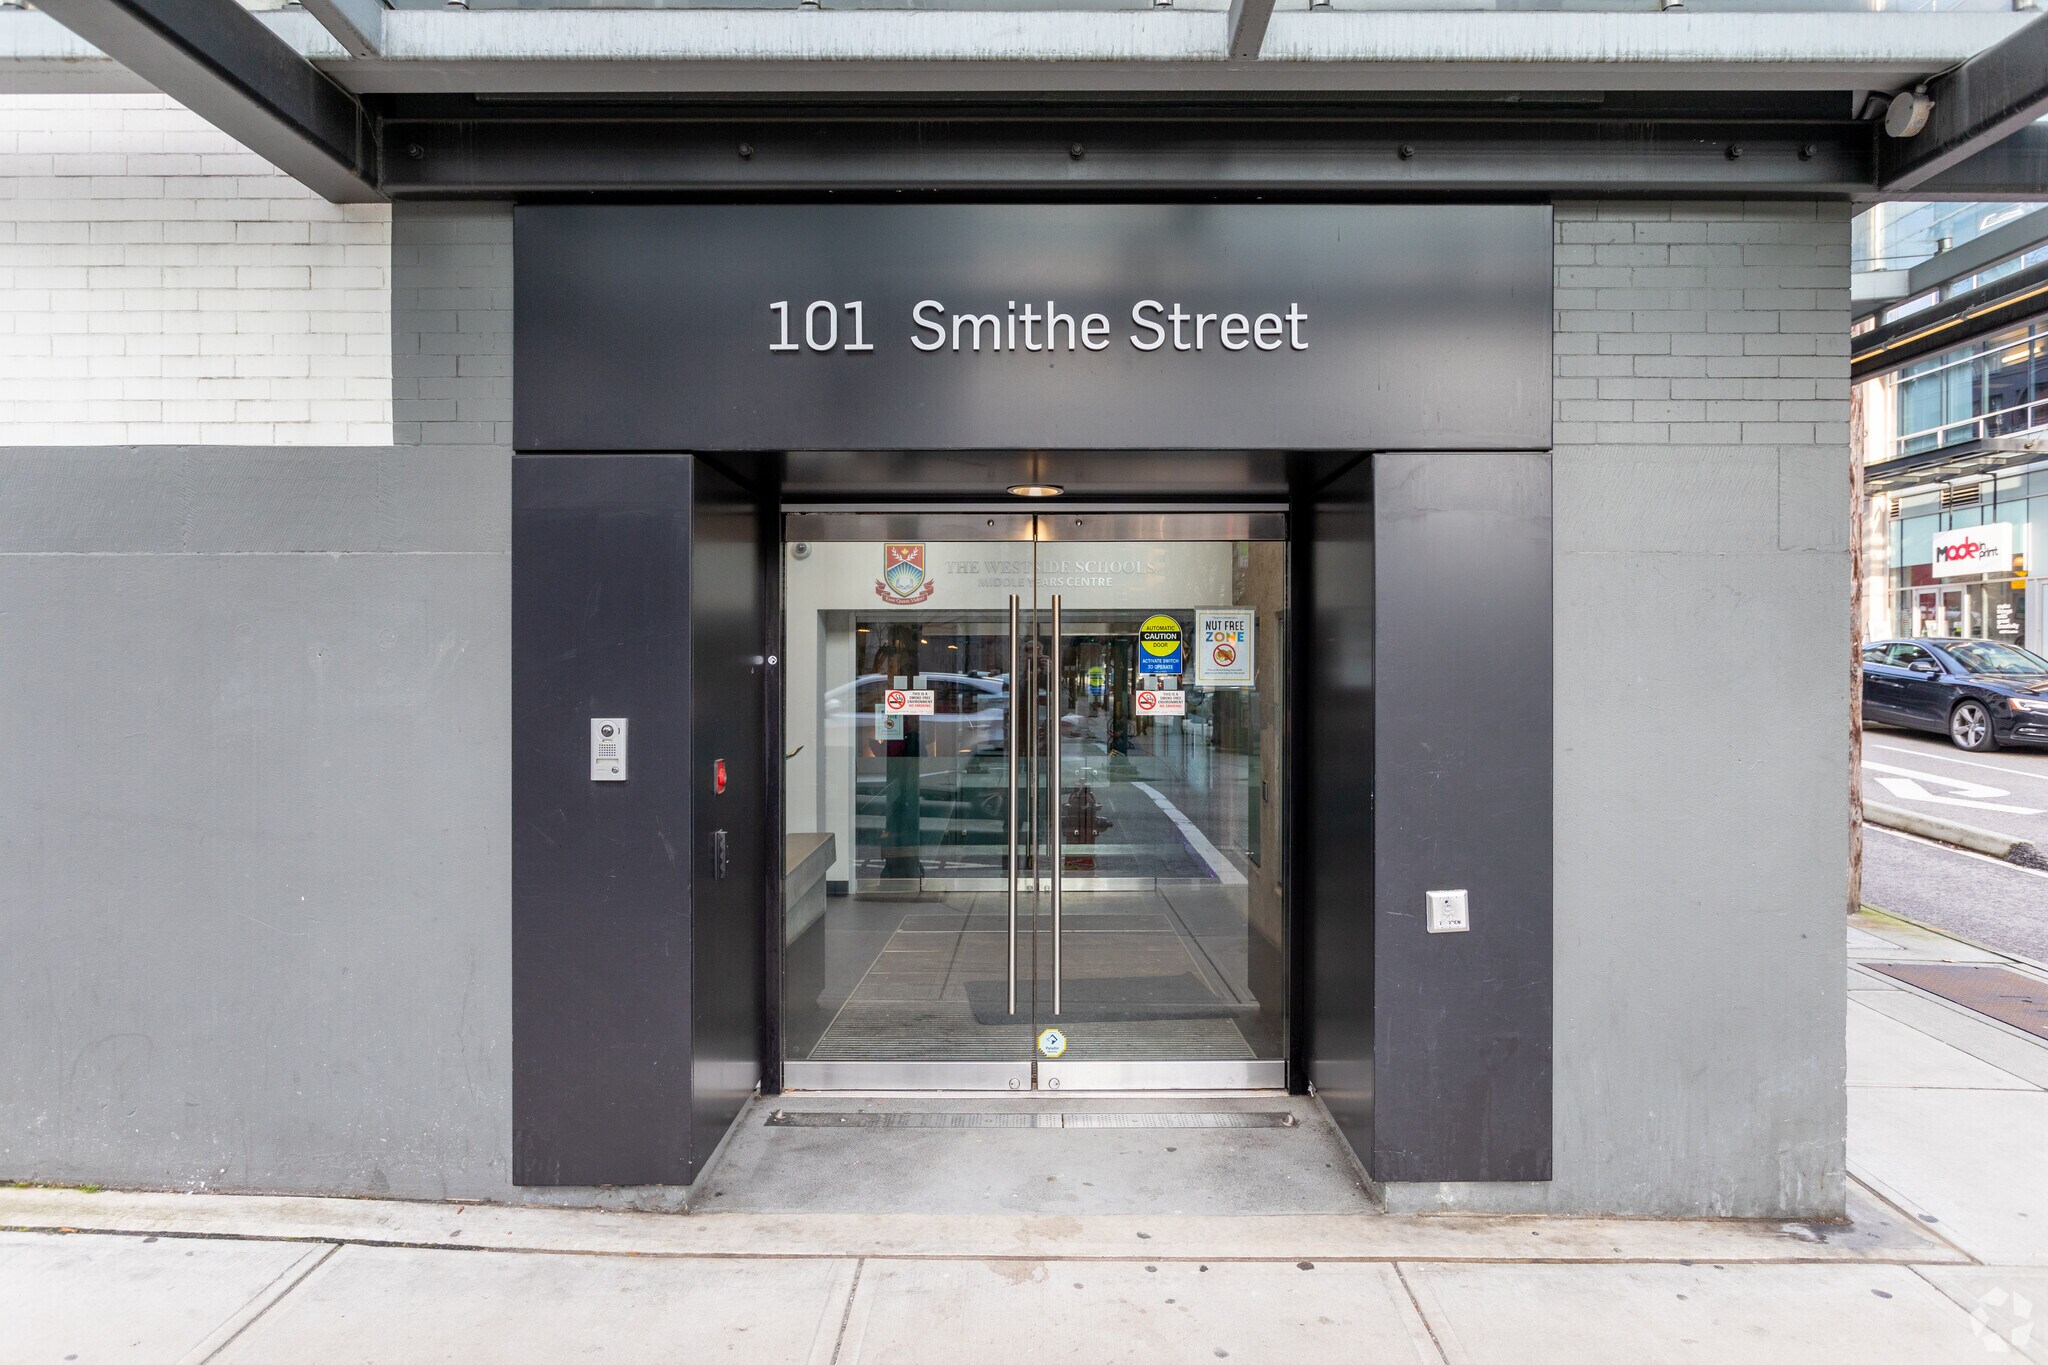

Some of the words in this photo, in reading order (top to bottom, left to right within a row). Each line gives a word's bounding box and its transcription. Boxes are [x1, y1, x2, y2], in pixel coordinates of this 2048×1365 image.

[769, 300, 874, 352] 101
[910, 300, 1110, 352] Smithe
[1130, 300, 1309, 352] Street
[945, 560, 980, 574] THE
[983, 560, 1072, 574] WESTSIDE
[1075, 560, 1155, 575] SCHOOLS
[978, 578, 1025, 588] MIDDLE
[1026, 577, 1064, 588] YEARS
[1066, 577, 1113, 588] CENTRE
[1205, 620, 1222, 631] NUT
[1224, 620, 1244, 631] FREE
[1205, 631, 1245, 643] ZONE
